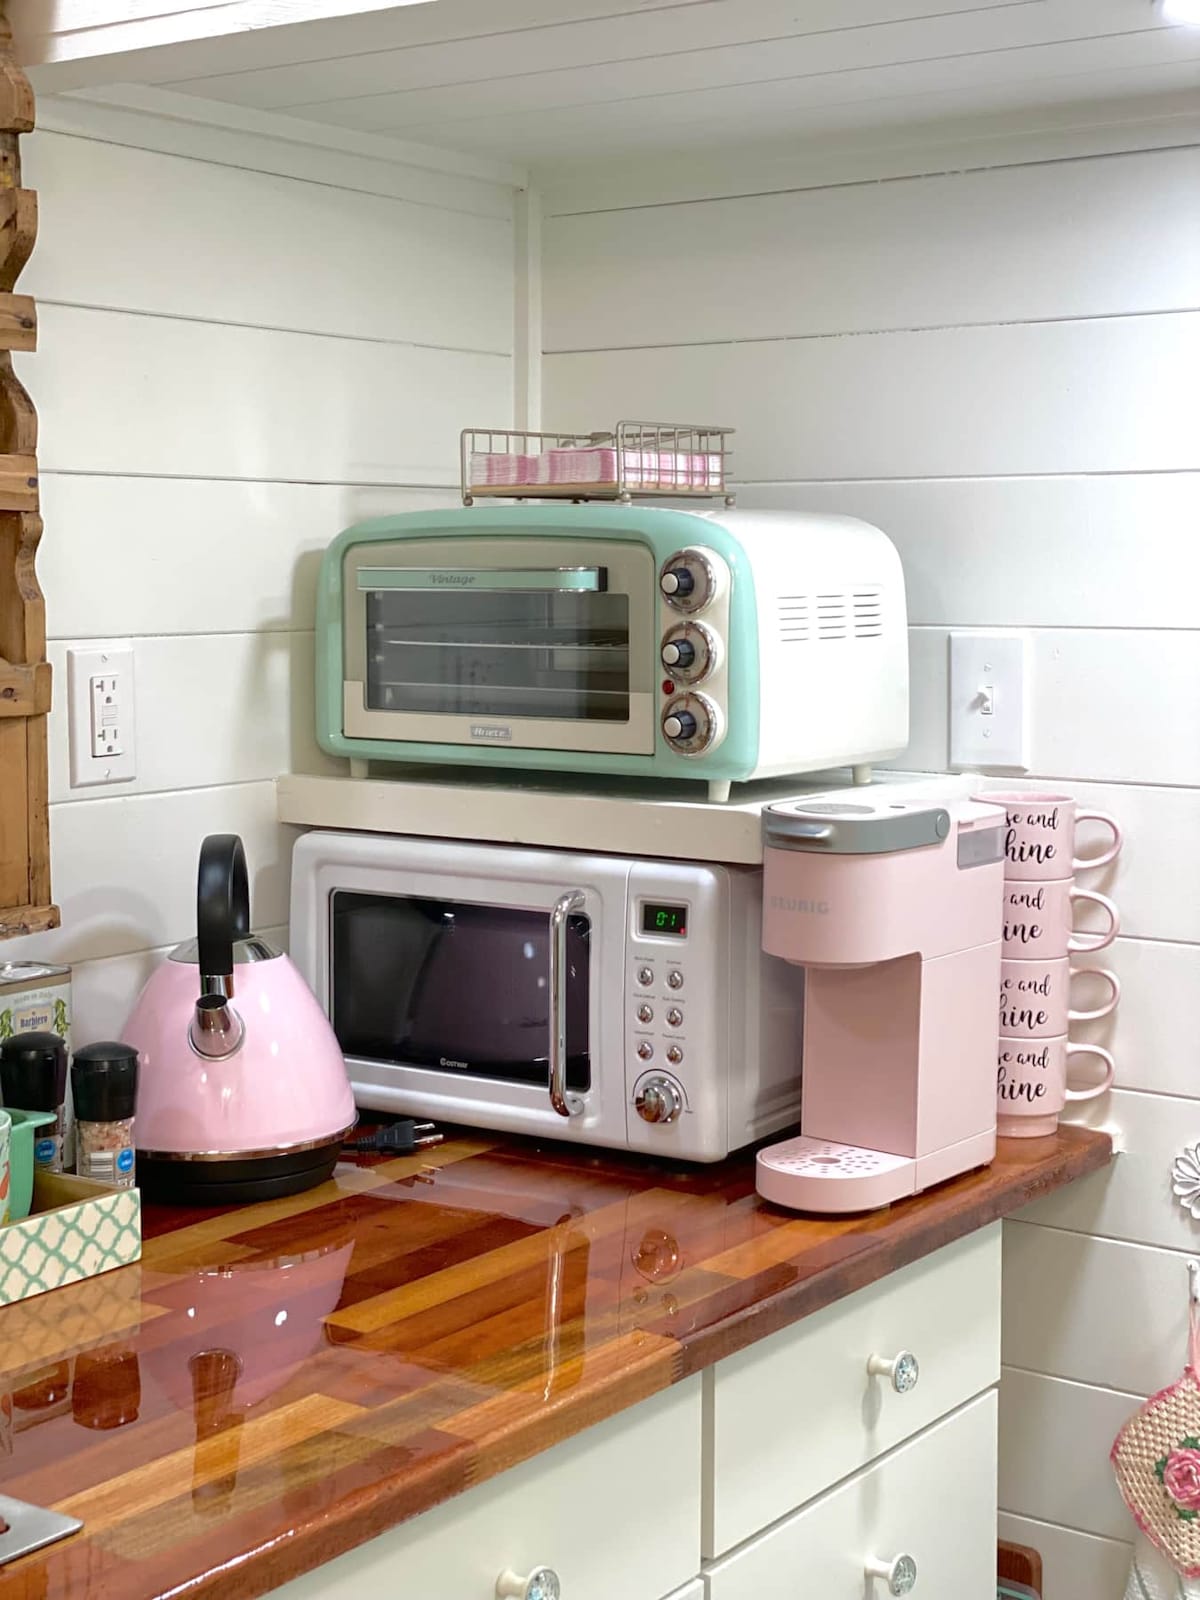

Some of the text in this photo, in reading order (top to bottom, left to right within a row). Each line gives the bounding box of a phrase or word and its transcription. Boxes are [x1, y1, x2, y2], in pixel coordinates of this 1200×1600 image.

[430, 574, 476, 586] Vintage
[1027, 807, 1059, 830] and
[1005, 828, 1056, 864] hine
[1010, 887, 1045, 911] and
[1003, 920, 1043, 943] ine
[1018, 974, 1051, 997] and
[1000, 993, 1048, 1030] hine
[1017, 1046, 1050, 1069] and
[997, 1066, 1047, 1102] hine
